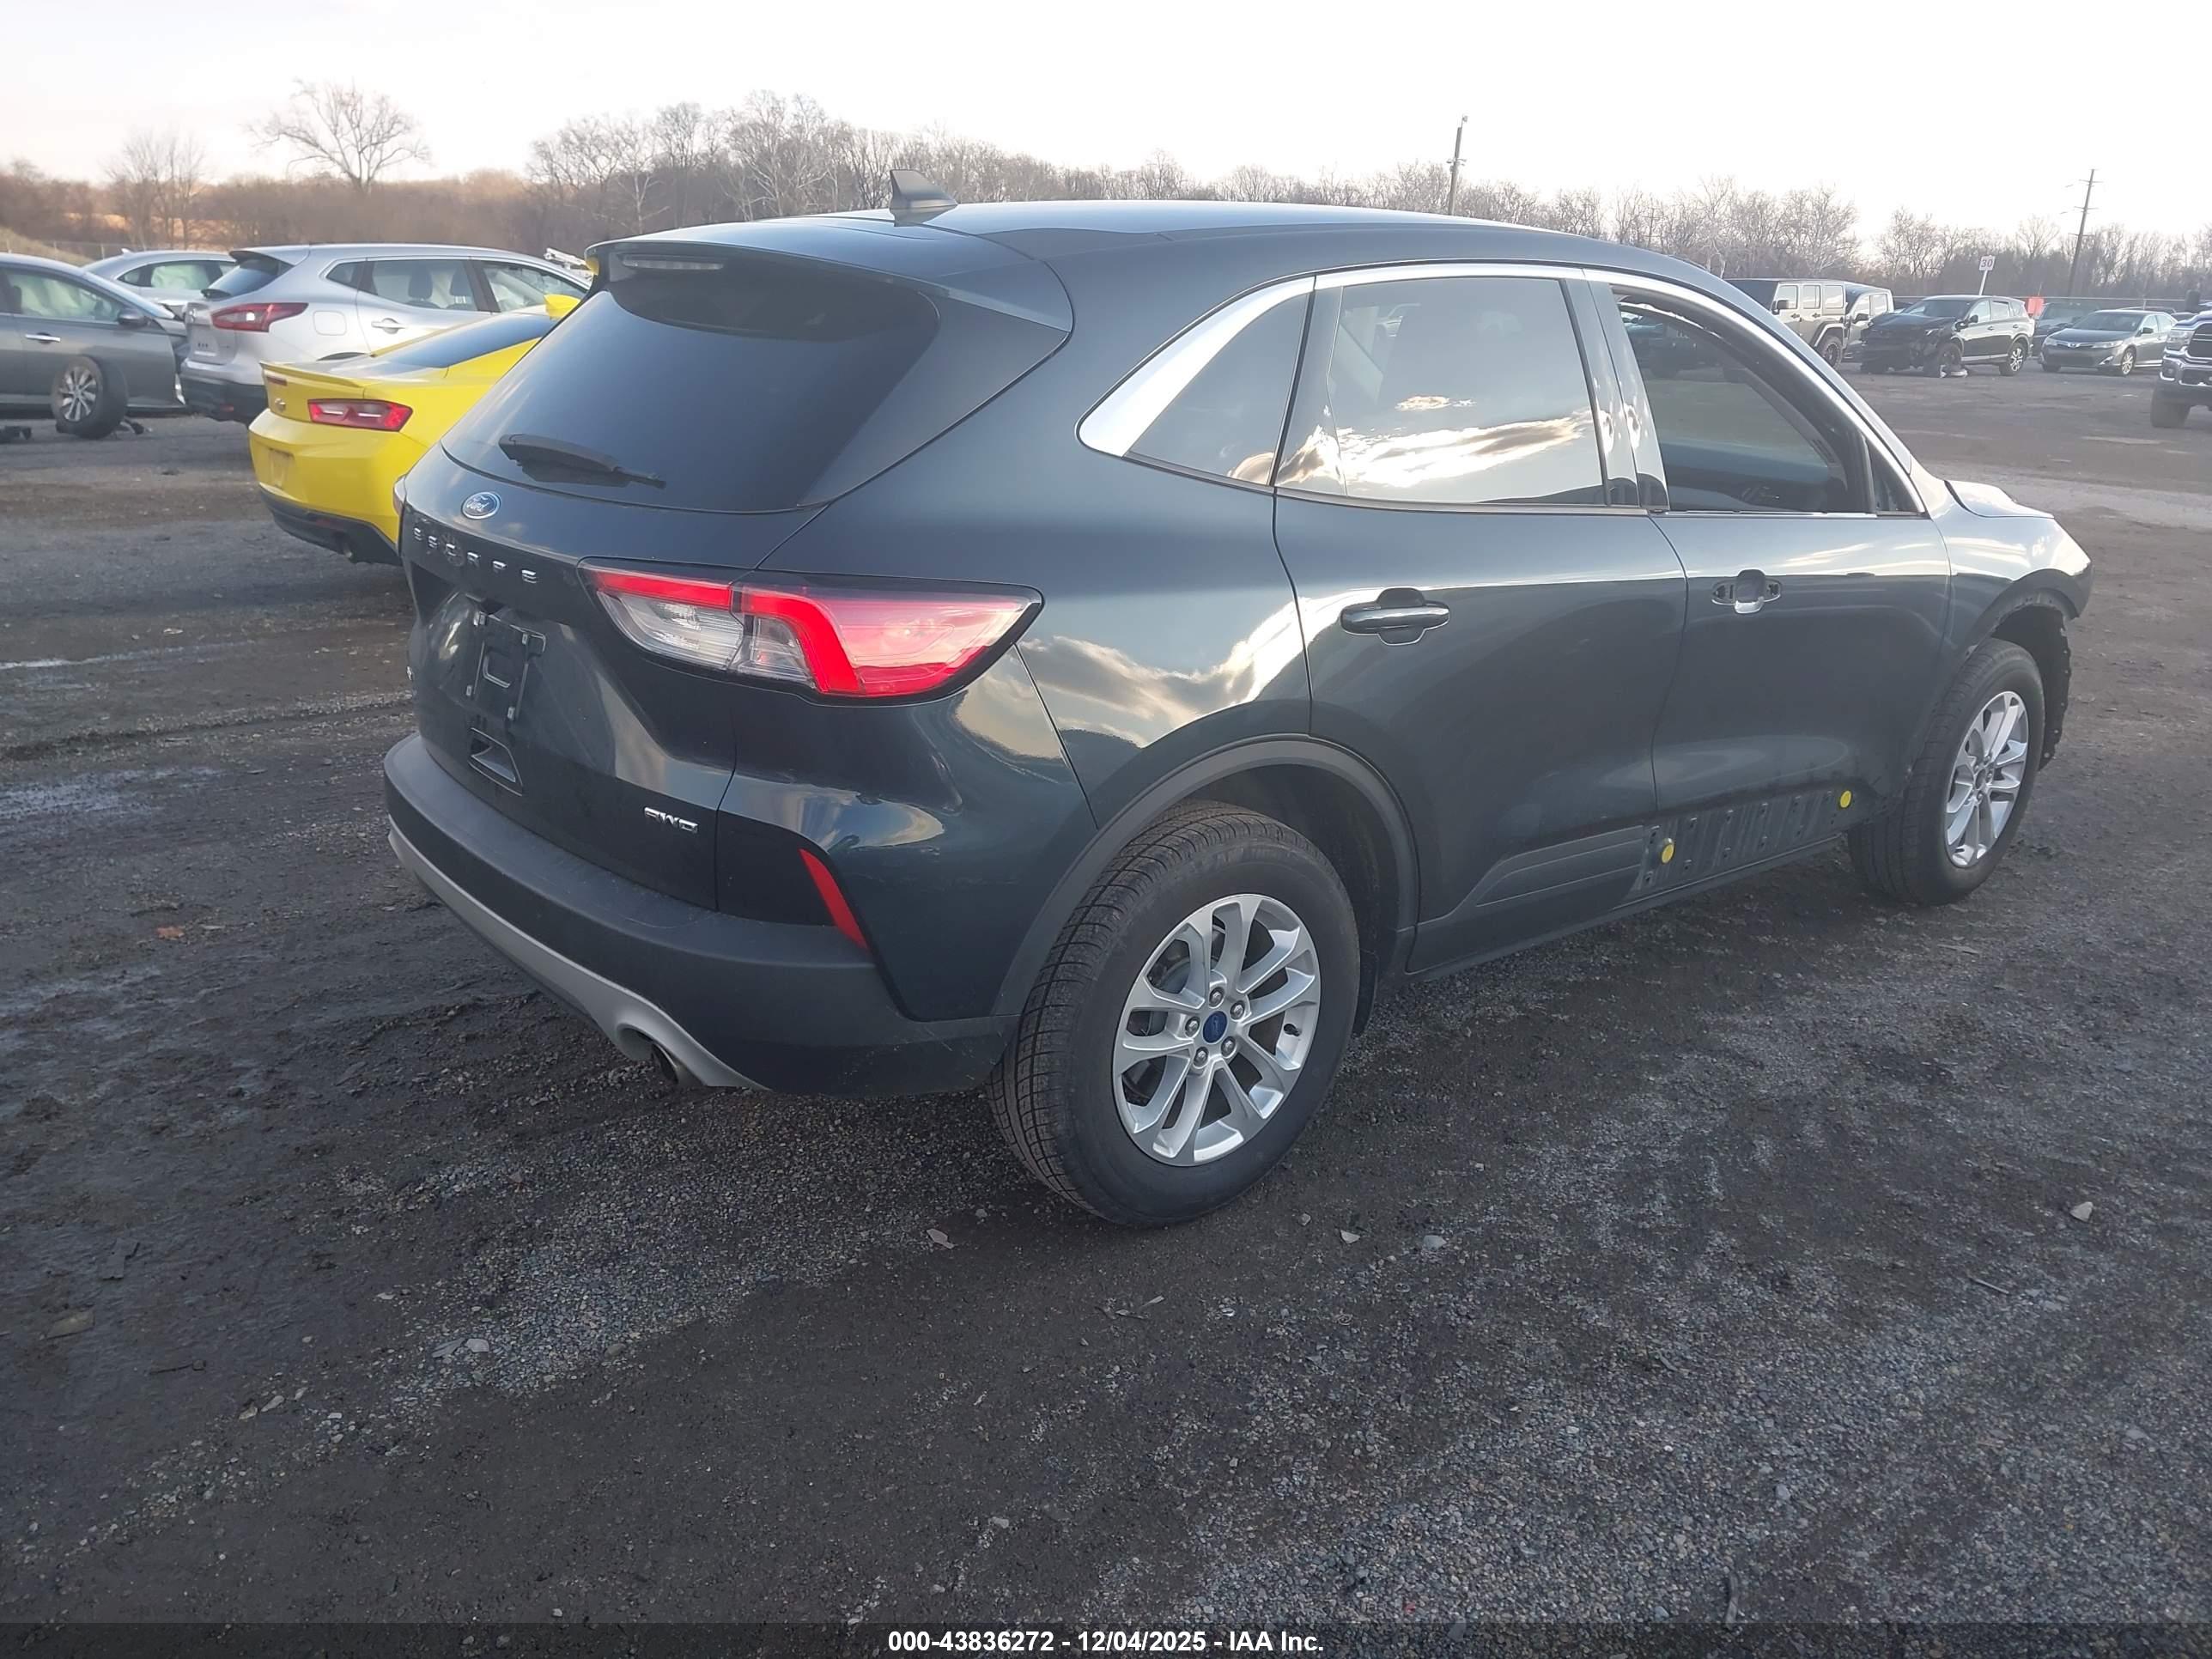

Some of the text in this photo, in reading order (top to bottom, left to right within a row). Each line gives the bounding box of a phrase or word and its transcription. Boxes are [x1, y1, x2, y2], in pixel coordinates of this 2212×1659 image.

[1980, 258, 1993, 268] 30
[414, 527, 538, 584] ESCAPE
[644, 807, 698, 834] AWD
